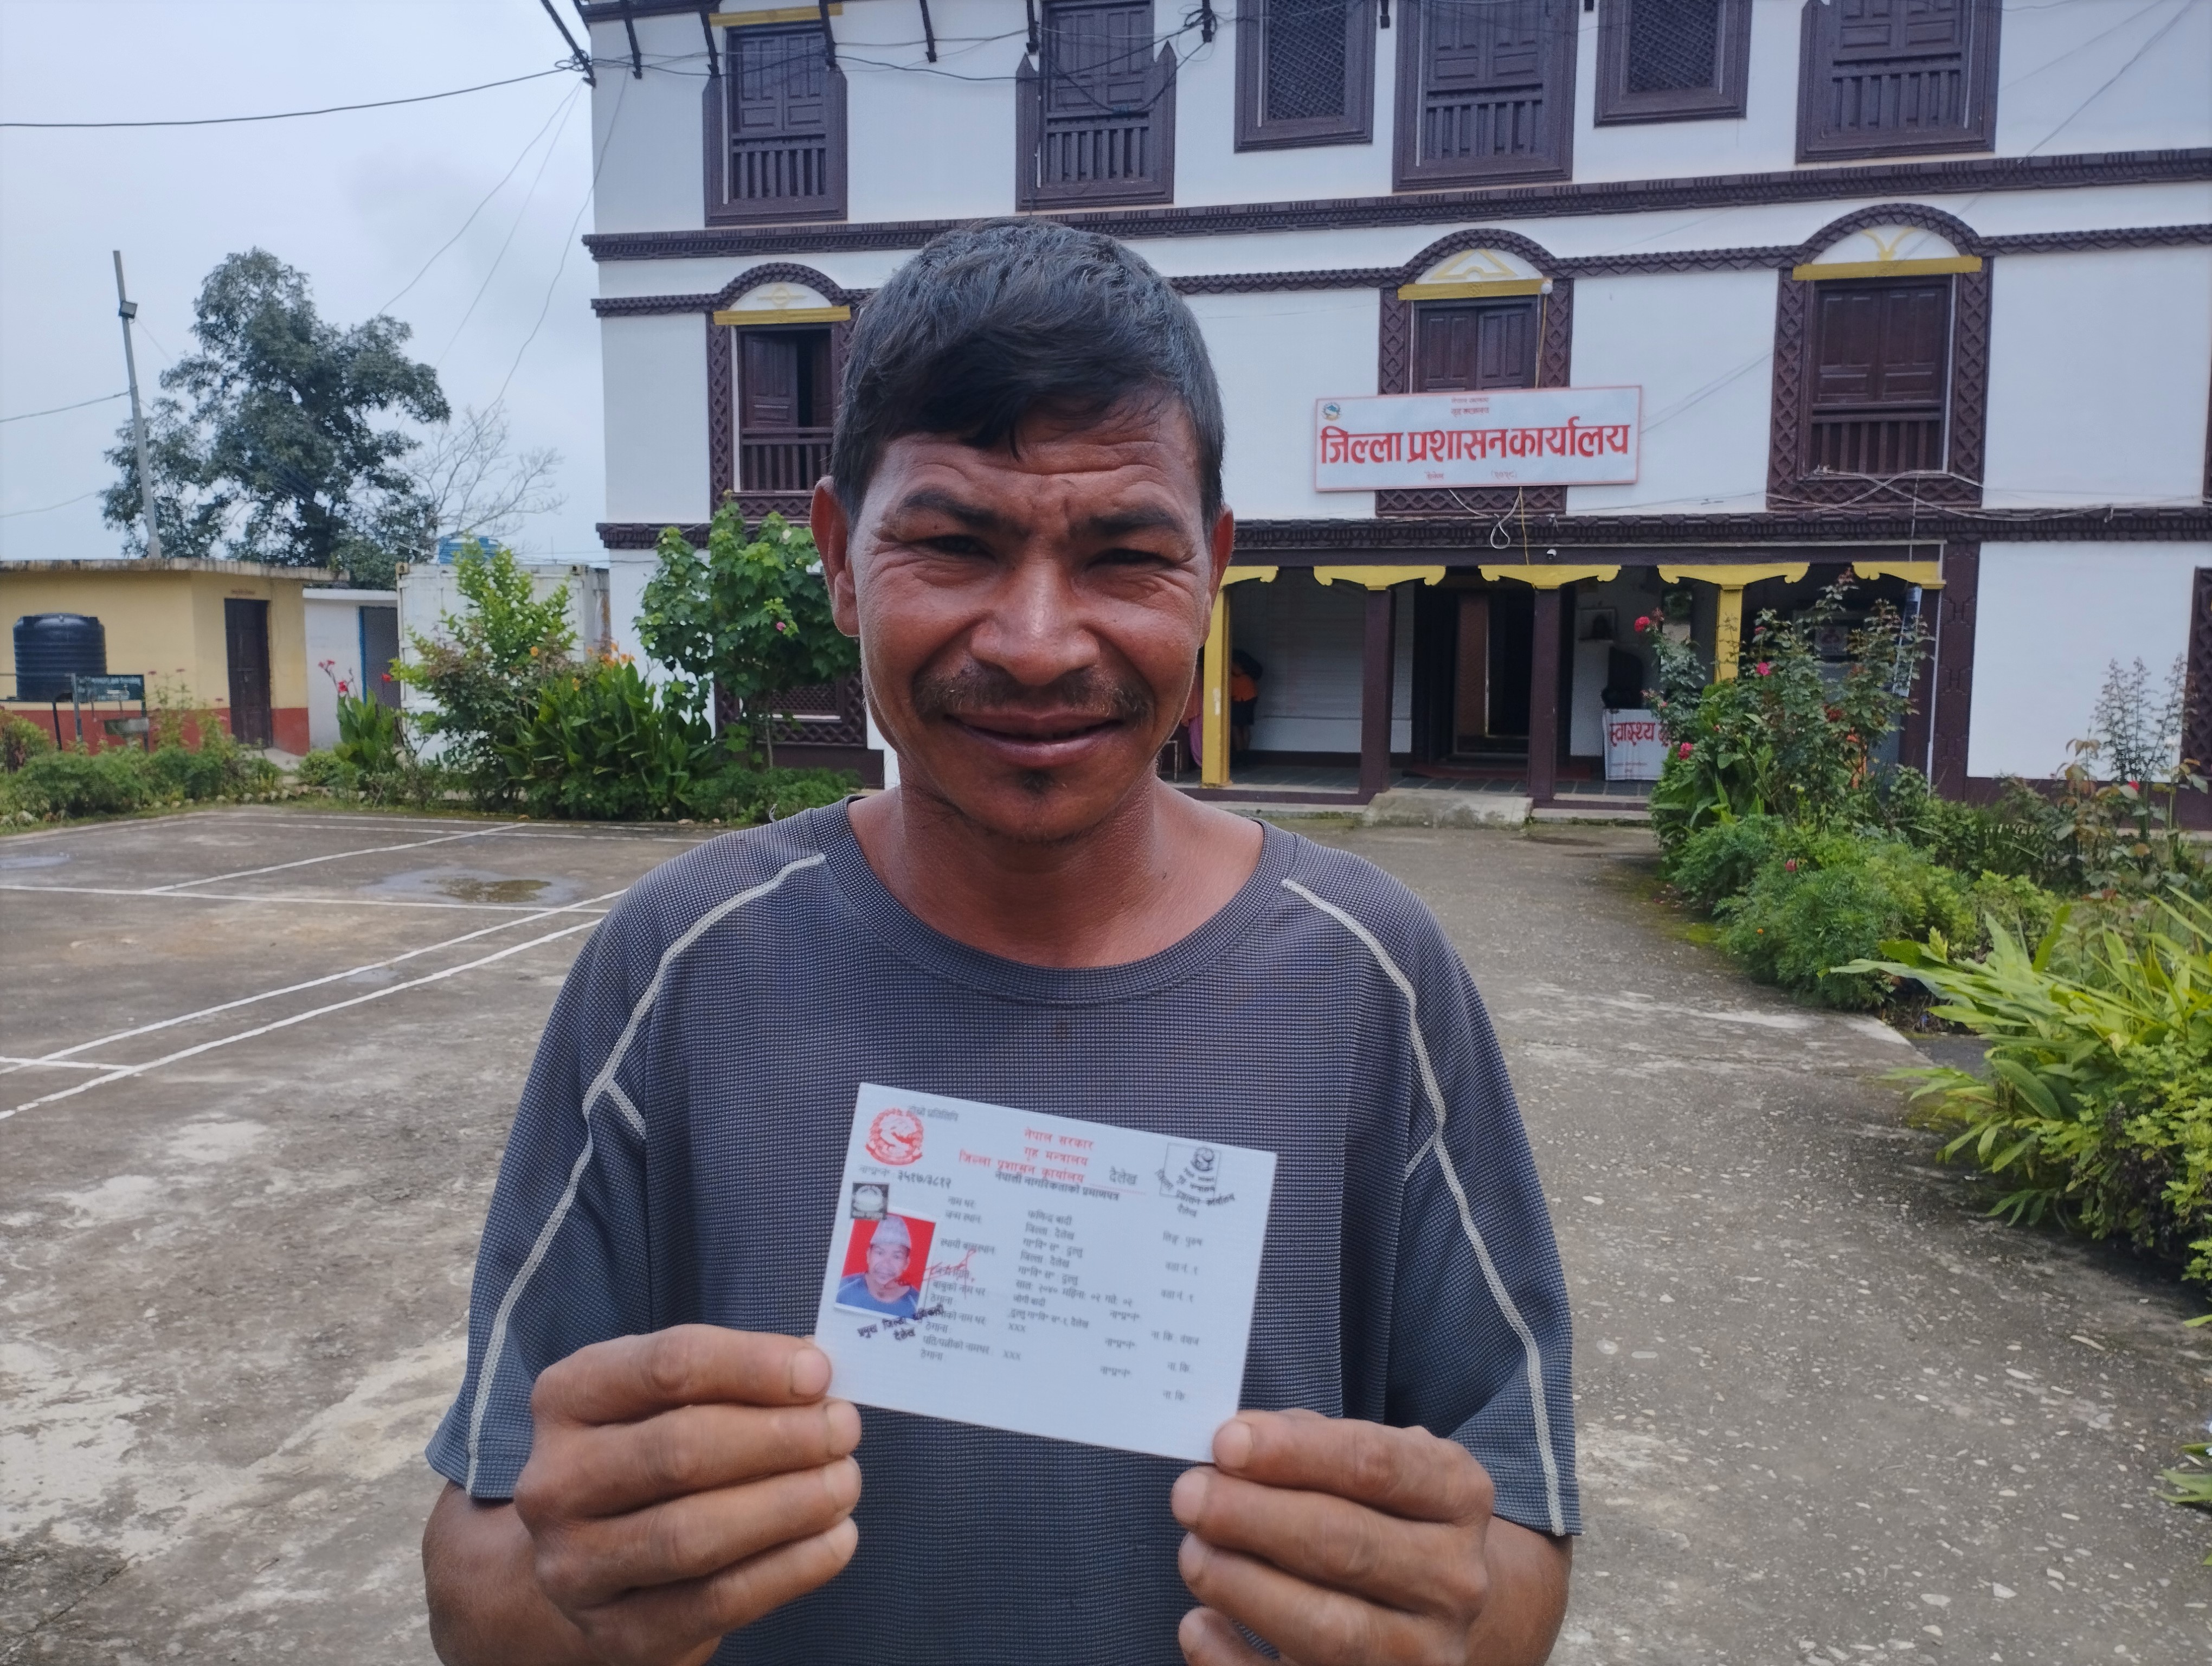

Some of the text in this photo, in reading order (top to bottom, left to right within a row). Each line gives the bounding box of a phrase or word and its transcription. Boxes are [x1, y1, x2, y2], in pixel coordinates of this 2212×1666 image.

[1321, 416, 1631, 463] जिल्ला प्रशासन कार्यालय
[1609, 721, 1655, 747] स्वास्थ्य
[1025, 1127, 1094, 1150] नेपाल सरकार
[959, 1148, 1085, 1183] जिल्ला प्रशासन कार्यालय
[1024, 1146, 1089, 1166] गृह मन्त्रालय
[1109, 1166, 1137, 1185] दैलेख
